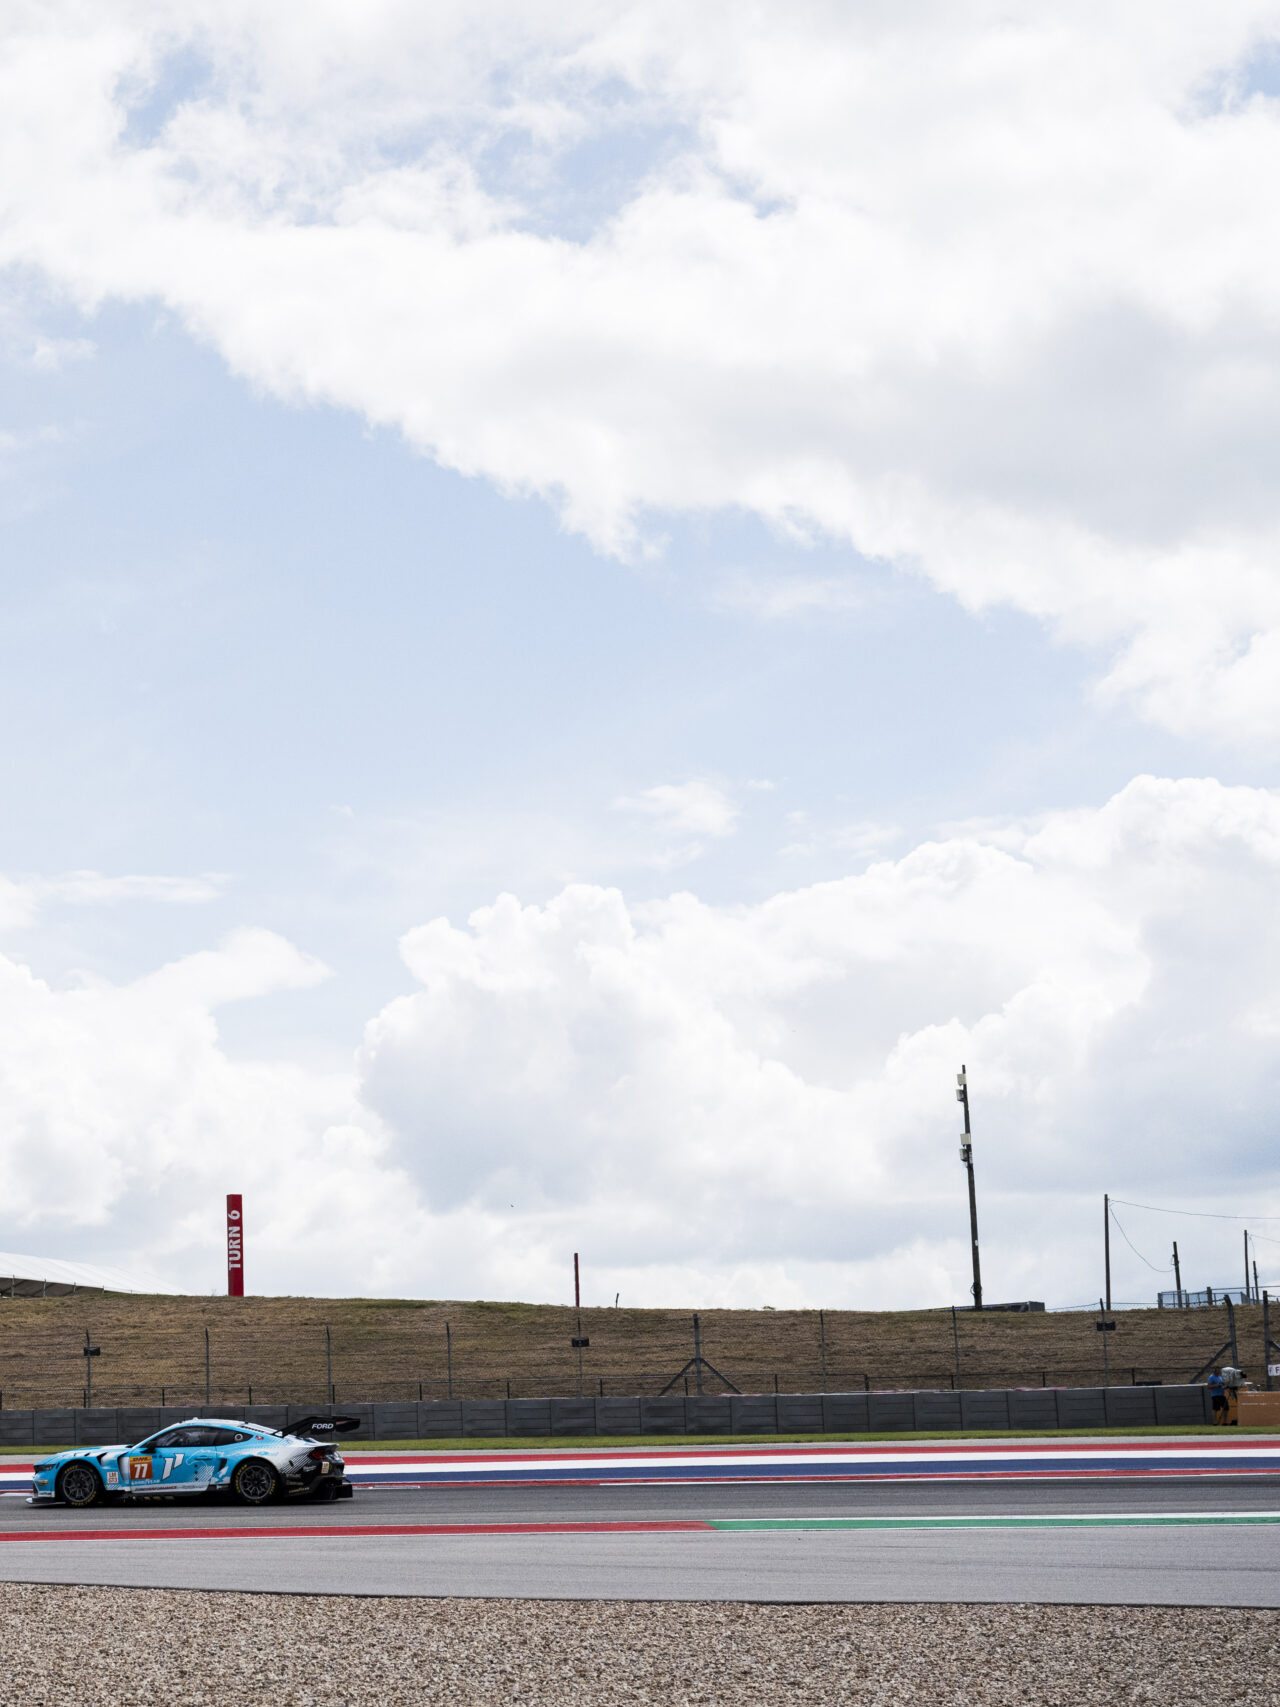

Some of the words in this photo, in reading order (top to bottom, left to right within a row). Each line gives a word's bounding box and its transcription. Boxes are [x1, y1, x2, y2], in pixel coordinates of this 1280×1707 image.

[228, 1210, 241, 1220] 6
[228, 1226, 241, 1271] TURN
[134, 1463, 148, 1479] 77
